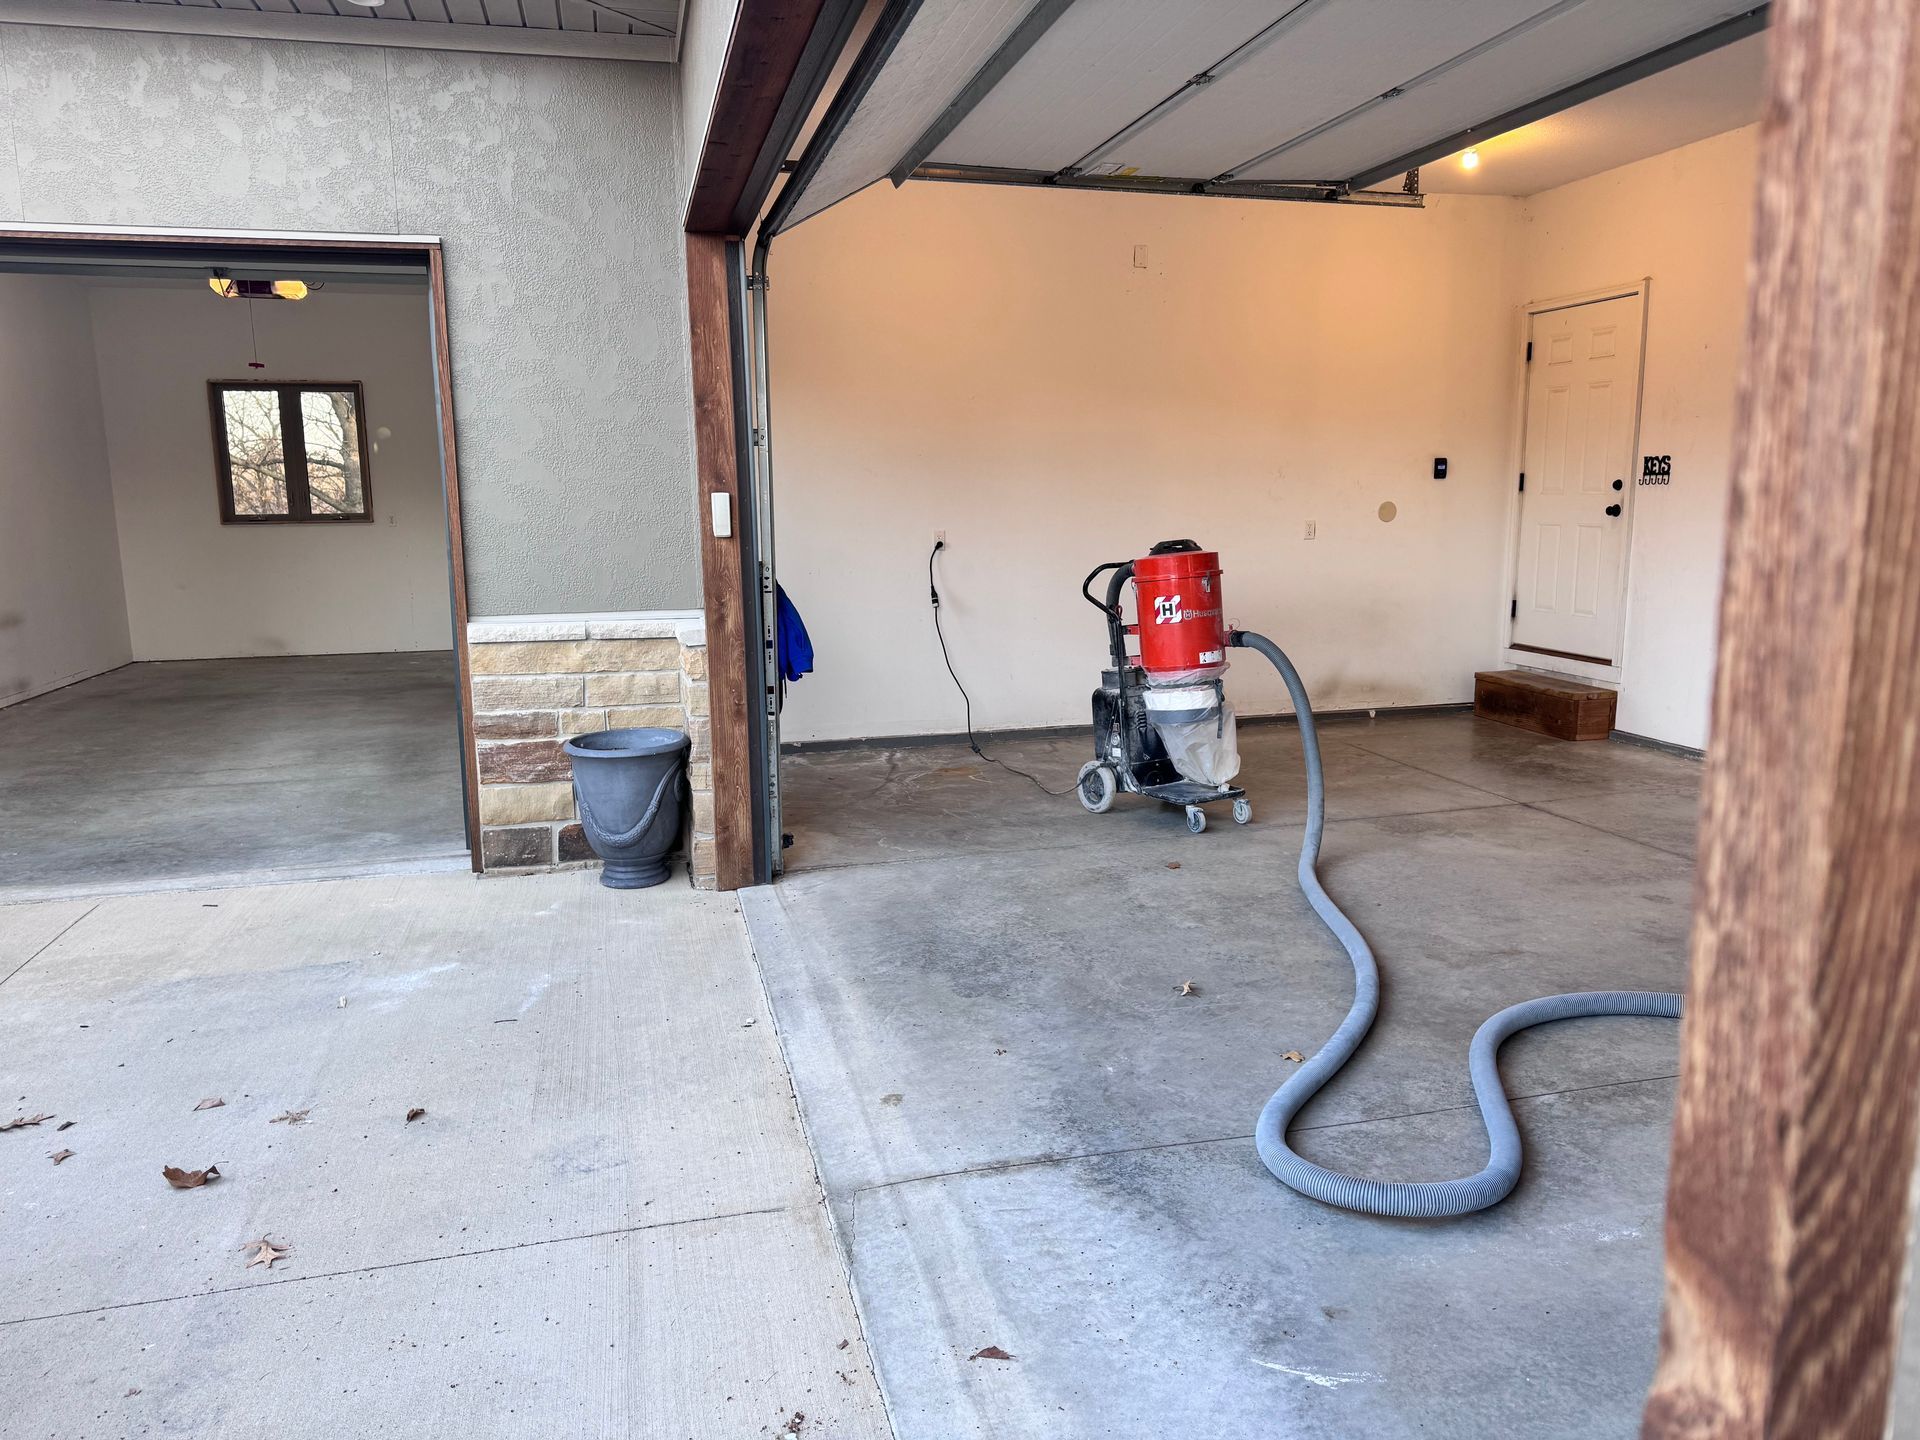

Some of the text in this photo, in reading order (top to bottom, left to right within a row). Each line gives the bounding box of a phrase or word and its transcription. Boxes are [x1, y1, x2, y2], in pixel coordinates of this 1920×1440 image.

[1643, 455, 1671, 475] KEYS
[1162, 604, 1174, 616] H
[1192, 608, 1222, 618] Husqv
